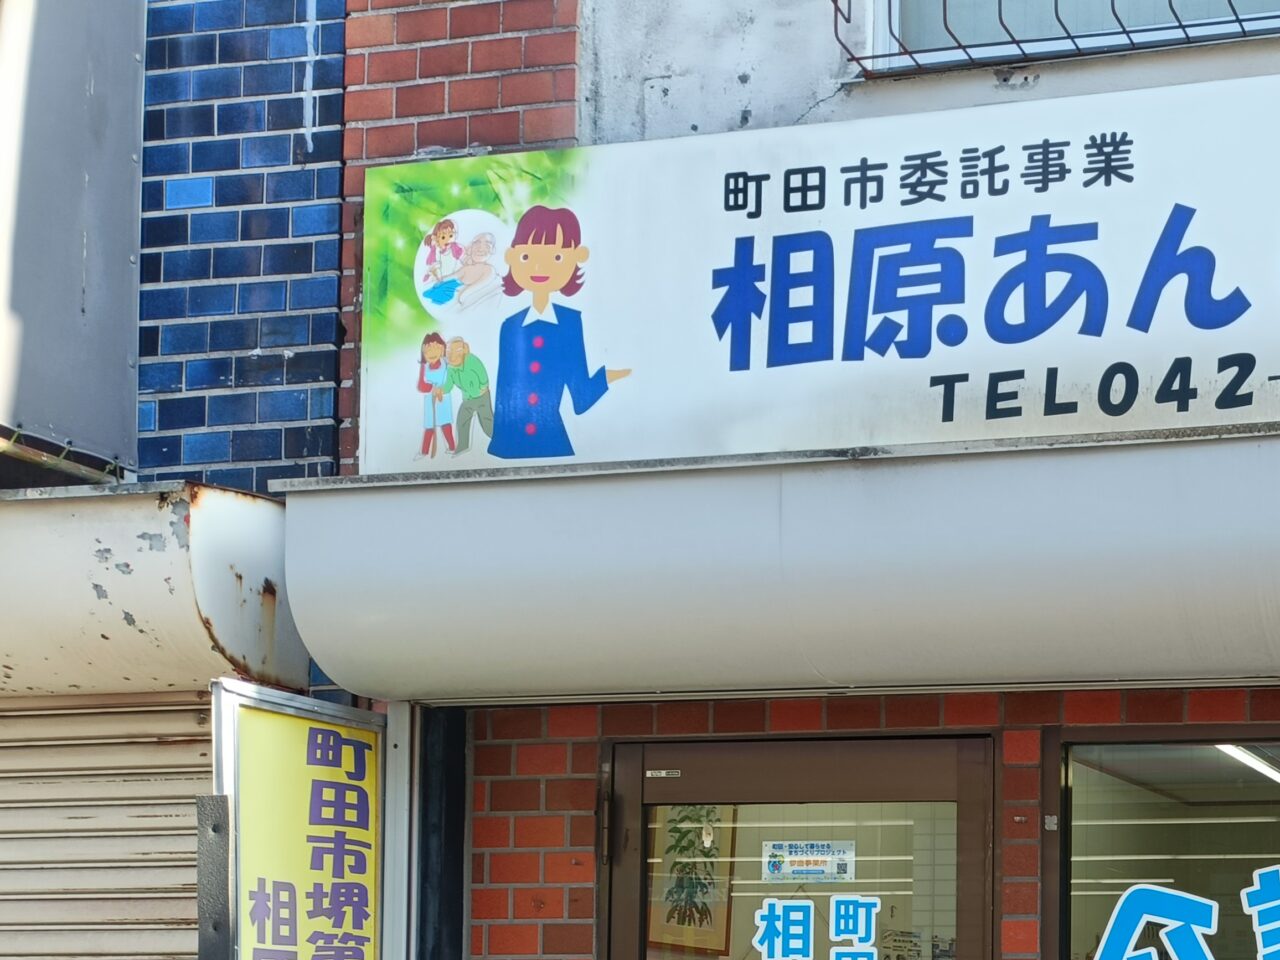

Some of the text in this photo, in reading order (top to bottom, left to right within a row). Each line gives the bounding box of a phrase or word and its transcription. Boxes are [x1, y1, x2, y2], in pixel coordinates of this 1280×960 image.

[724, 131, 1135, 220] 町田市委託事業
